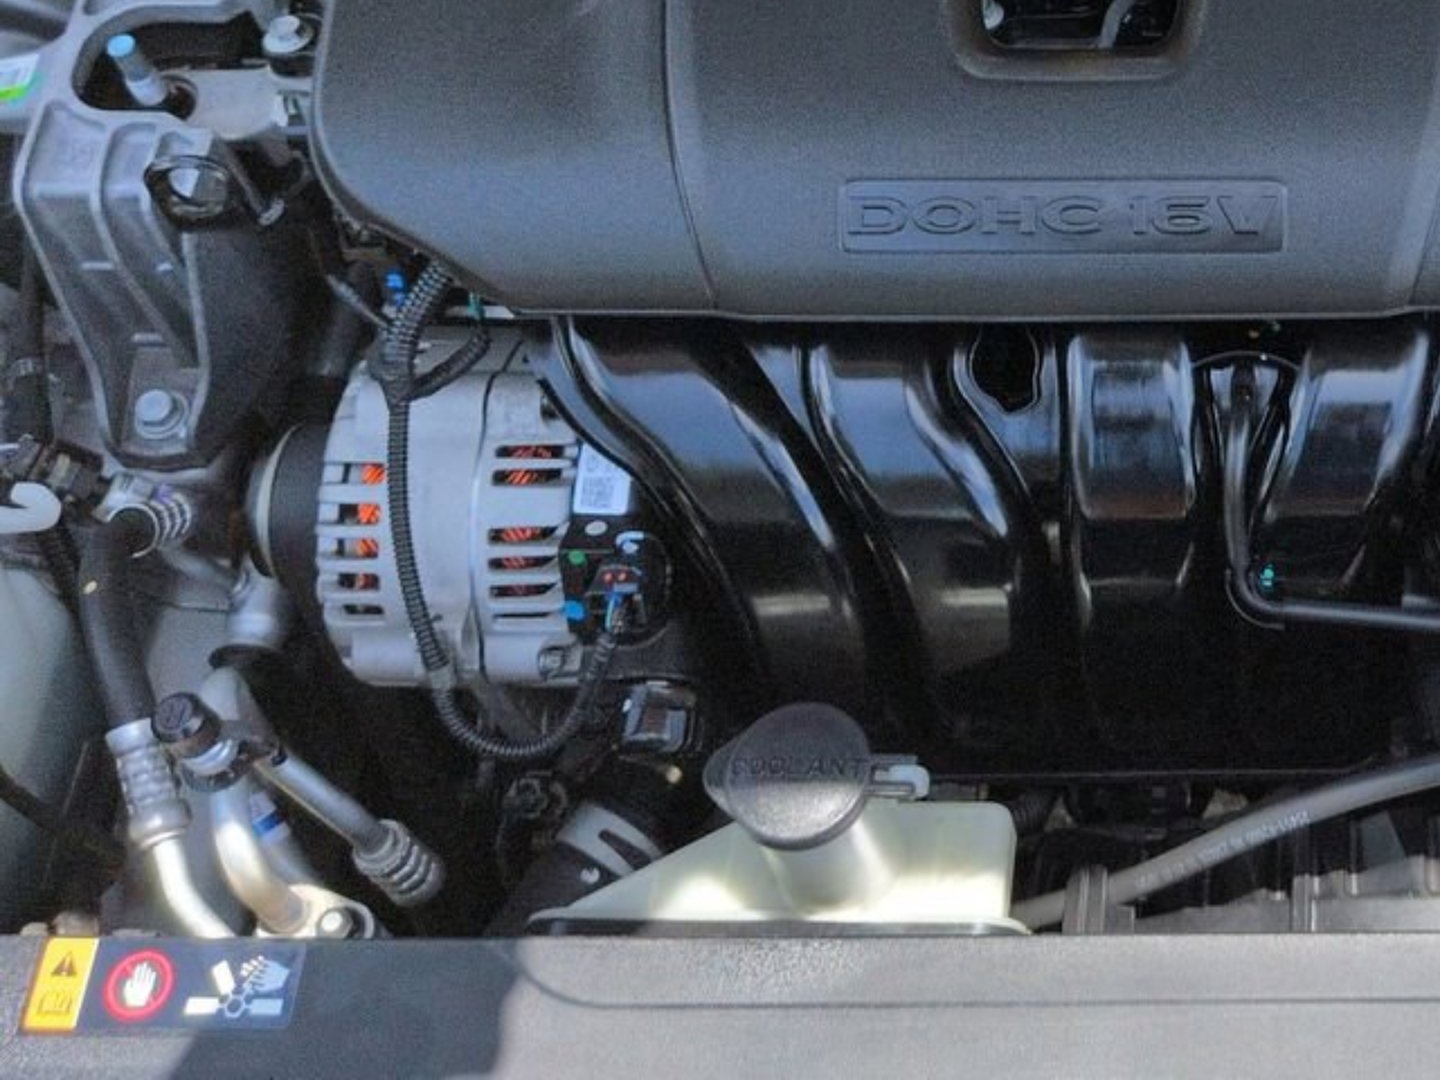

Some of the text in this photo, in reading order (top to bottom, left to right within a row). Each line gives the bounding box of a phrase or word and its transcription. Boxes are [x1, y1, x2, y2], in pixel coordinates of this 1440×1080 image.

[848, 195, 1280, 236] DOHC 16V
[730, 756, 866, 780] COOLANT
